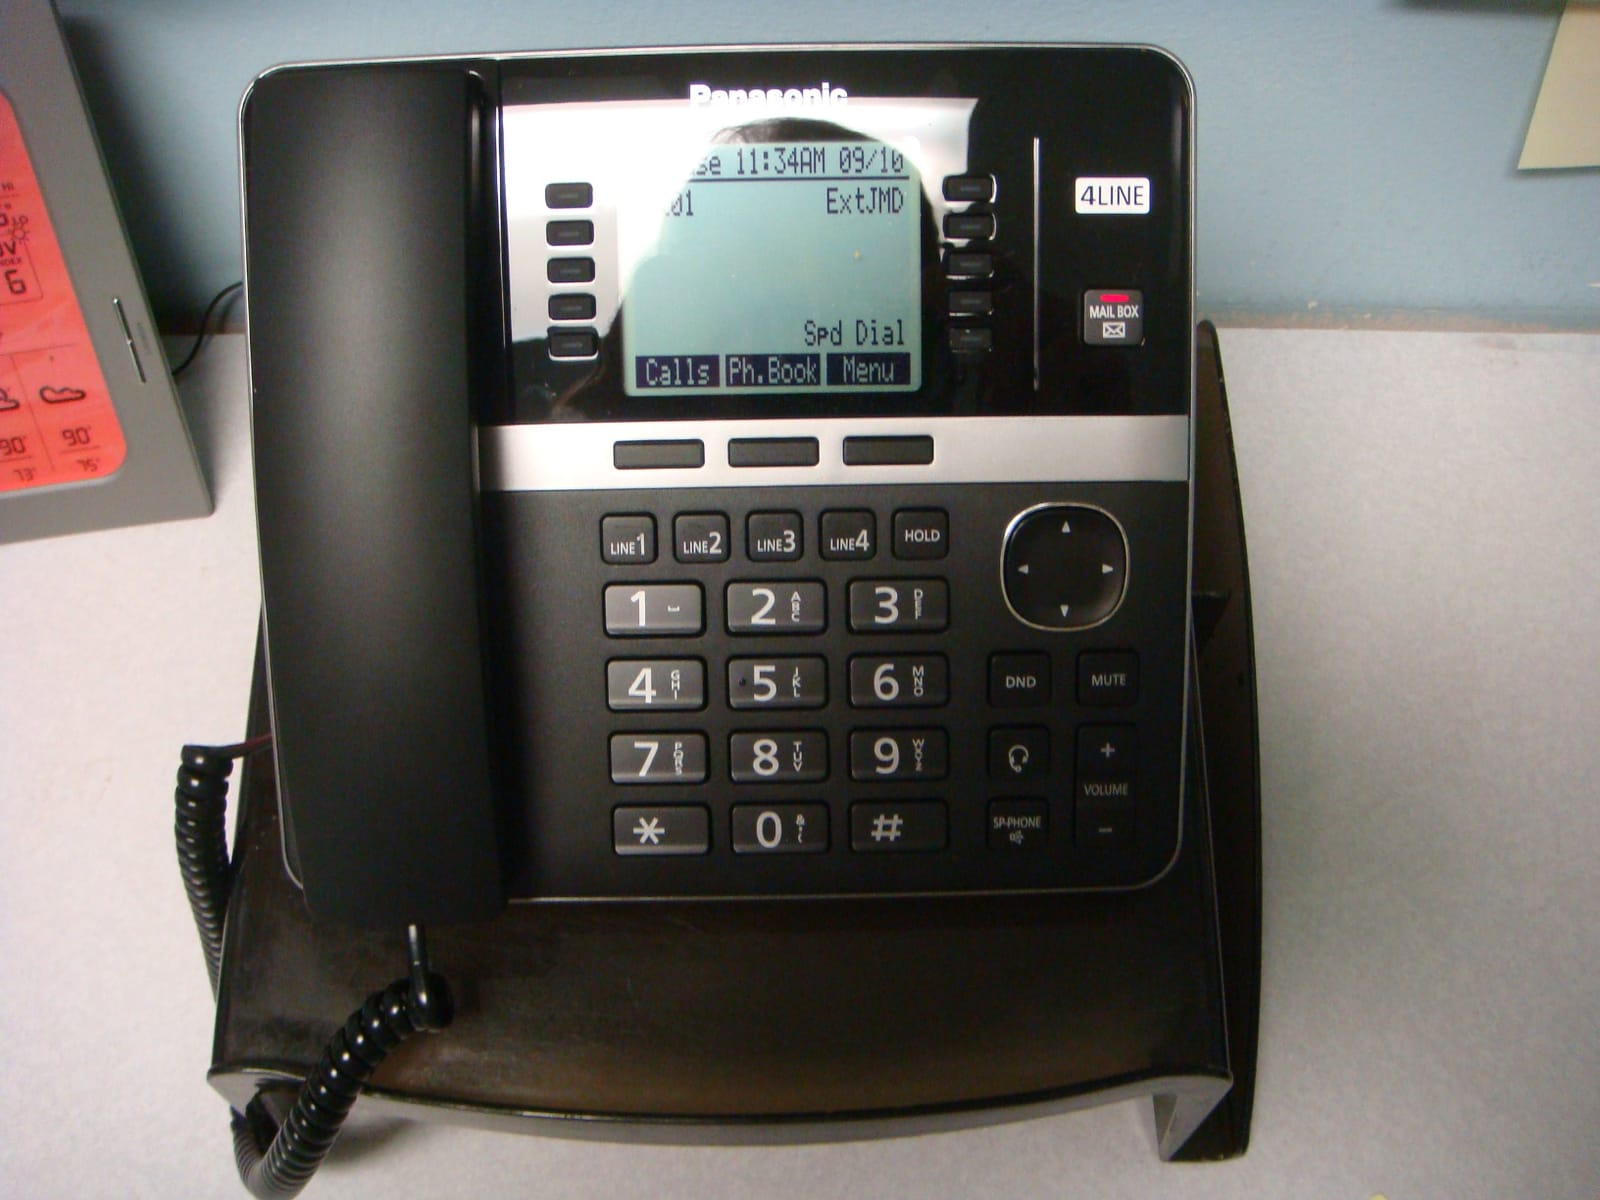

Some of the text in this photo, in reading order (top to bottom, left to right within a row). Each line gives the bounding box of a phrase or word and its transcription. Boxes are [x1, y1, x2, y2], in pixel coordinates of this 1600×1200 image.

[689, 82, 848, 105] Panasonic
[737, 146, 826, 175] 11:34AM
[839, 147, 904, 174] 09/10
[826, 187, 904, 214] ExtJMD
[1080, 185, 1144, 206] 4LINE
[1089, 304, 1139, 319] MAIL BOX
[804, 319, 905, 347] Spd Dial
[645, 358, 710, 386] Calls
[728, 355, 818, 385] Ph.Book
[843, 354, 895, 383] Menu
[904, 529, 941, 543] HOLD
[630, 590, 647, 628] 1
[751, 588, 776, 625] 2
[874, 586, 899, 624] 3
[628, 667, 657, 704] 4
[753, 664, 777, 702] 5
[873, 663, 899, 701] 6
[1005, 675, 1037, 689] DND
[1091, 673, 1126, 687] MUTE
[633, 741, 659, 777] 7
[752, 738, 779, 776] 8
[873, 737, 900, 775] 9
[1083, 783, 1128, 796] VOLUME
[756, 811, 782, 848] 0
